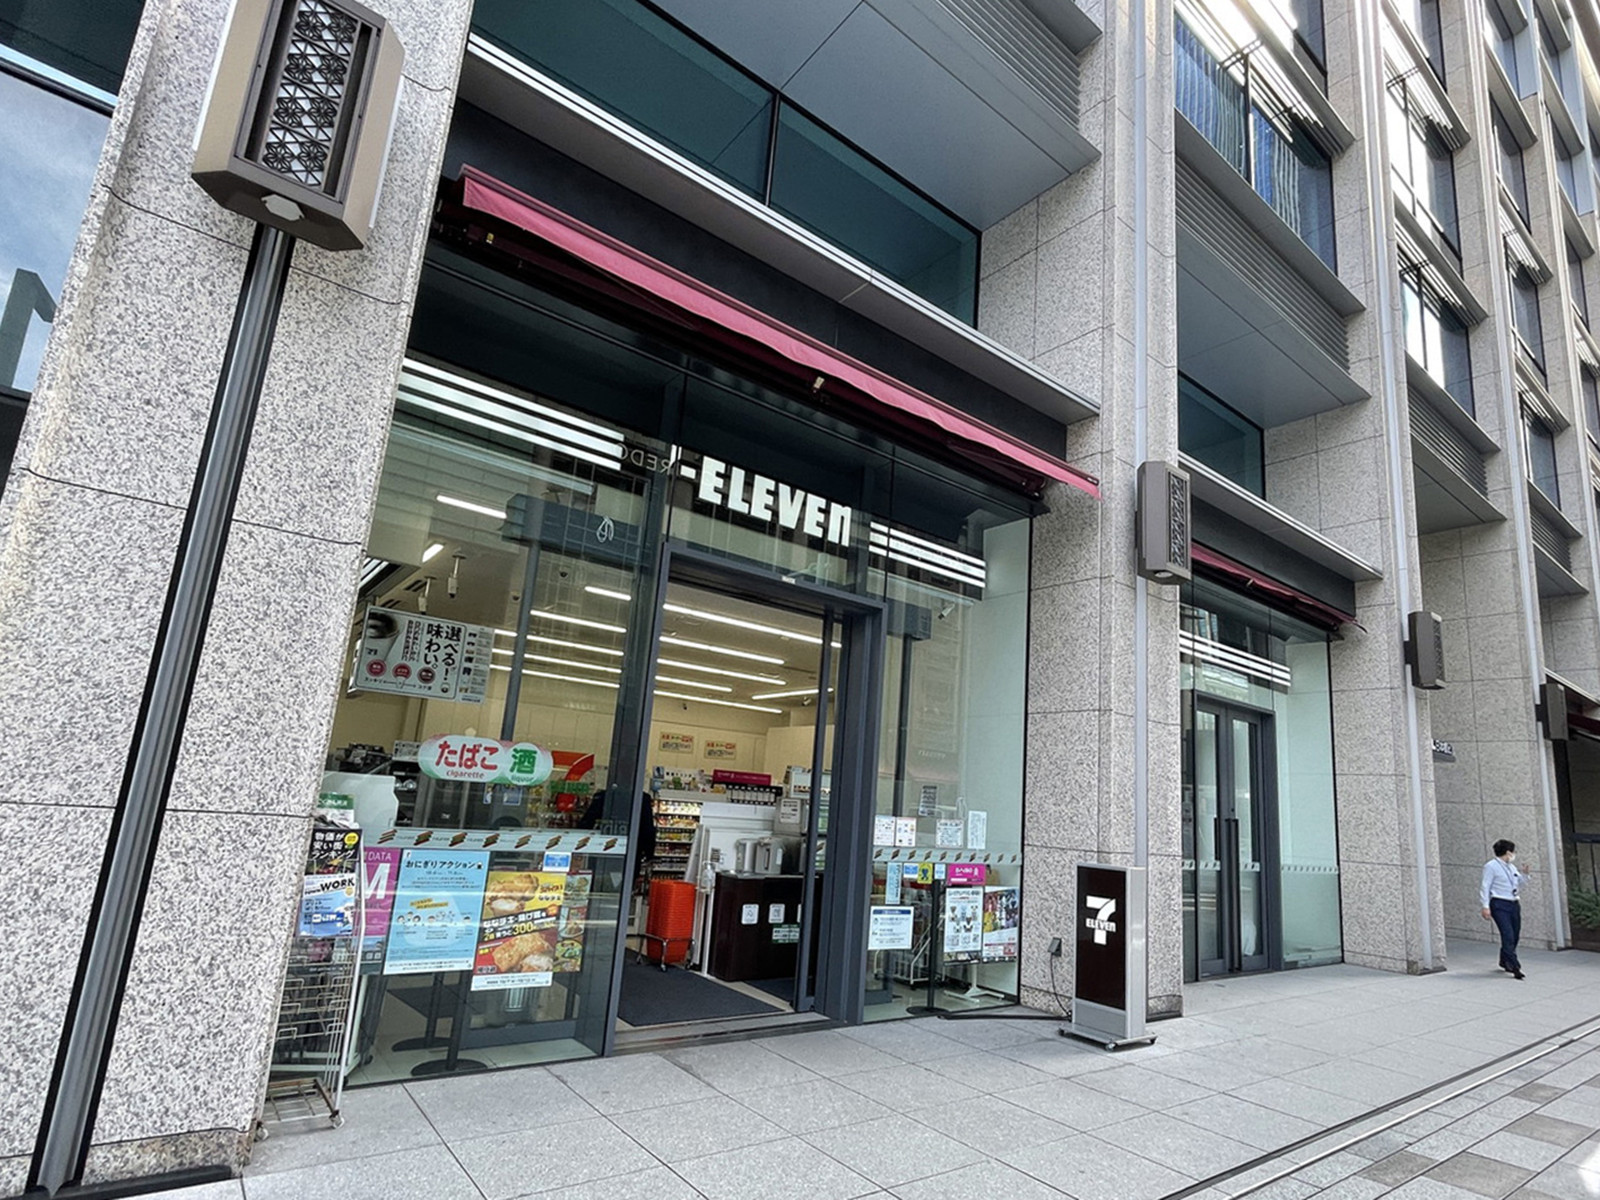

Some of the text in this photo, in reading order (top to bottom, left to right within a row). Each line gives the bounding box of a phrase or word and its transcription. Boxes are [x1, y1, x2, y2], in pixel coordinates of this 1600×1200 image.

[435, 740, 499, 771] たばこ
[509, 748, 538, 775] 酒
[446, 769, 484, 779] cigarette
[367, 851, 392, 861] DATA
[405, 860, 476, 869] おにぎりアクション
[320, 877, 355, 892] WORK
[1086, 895, 1116, 945] 7
